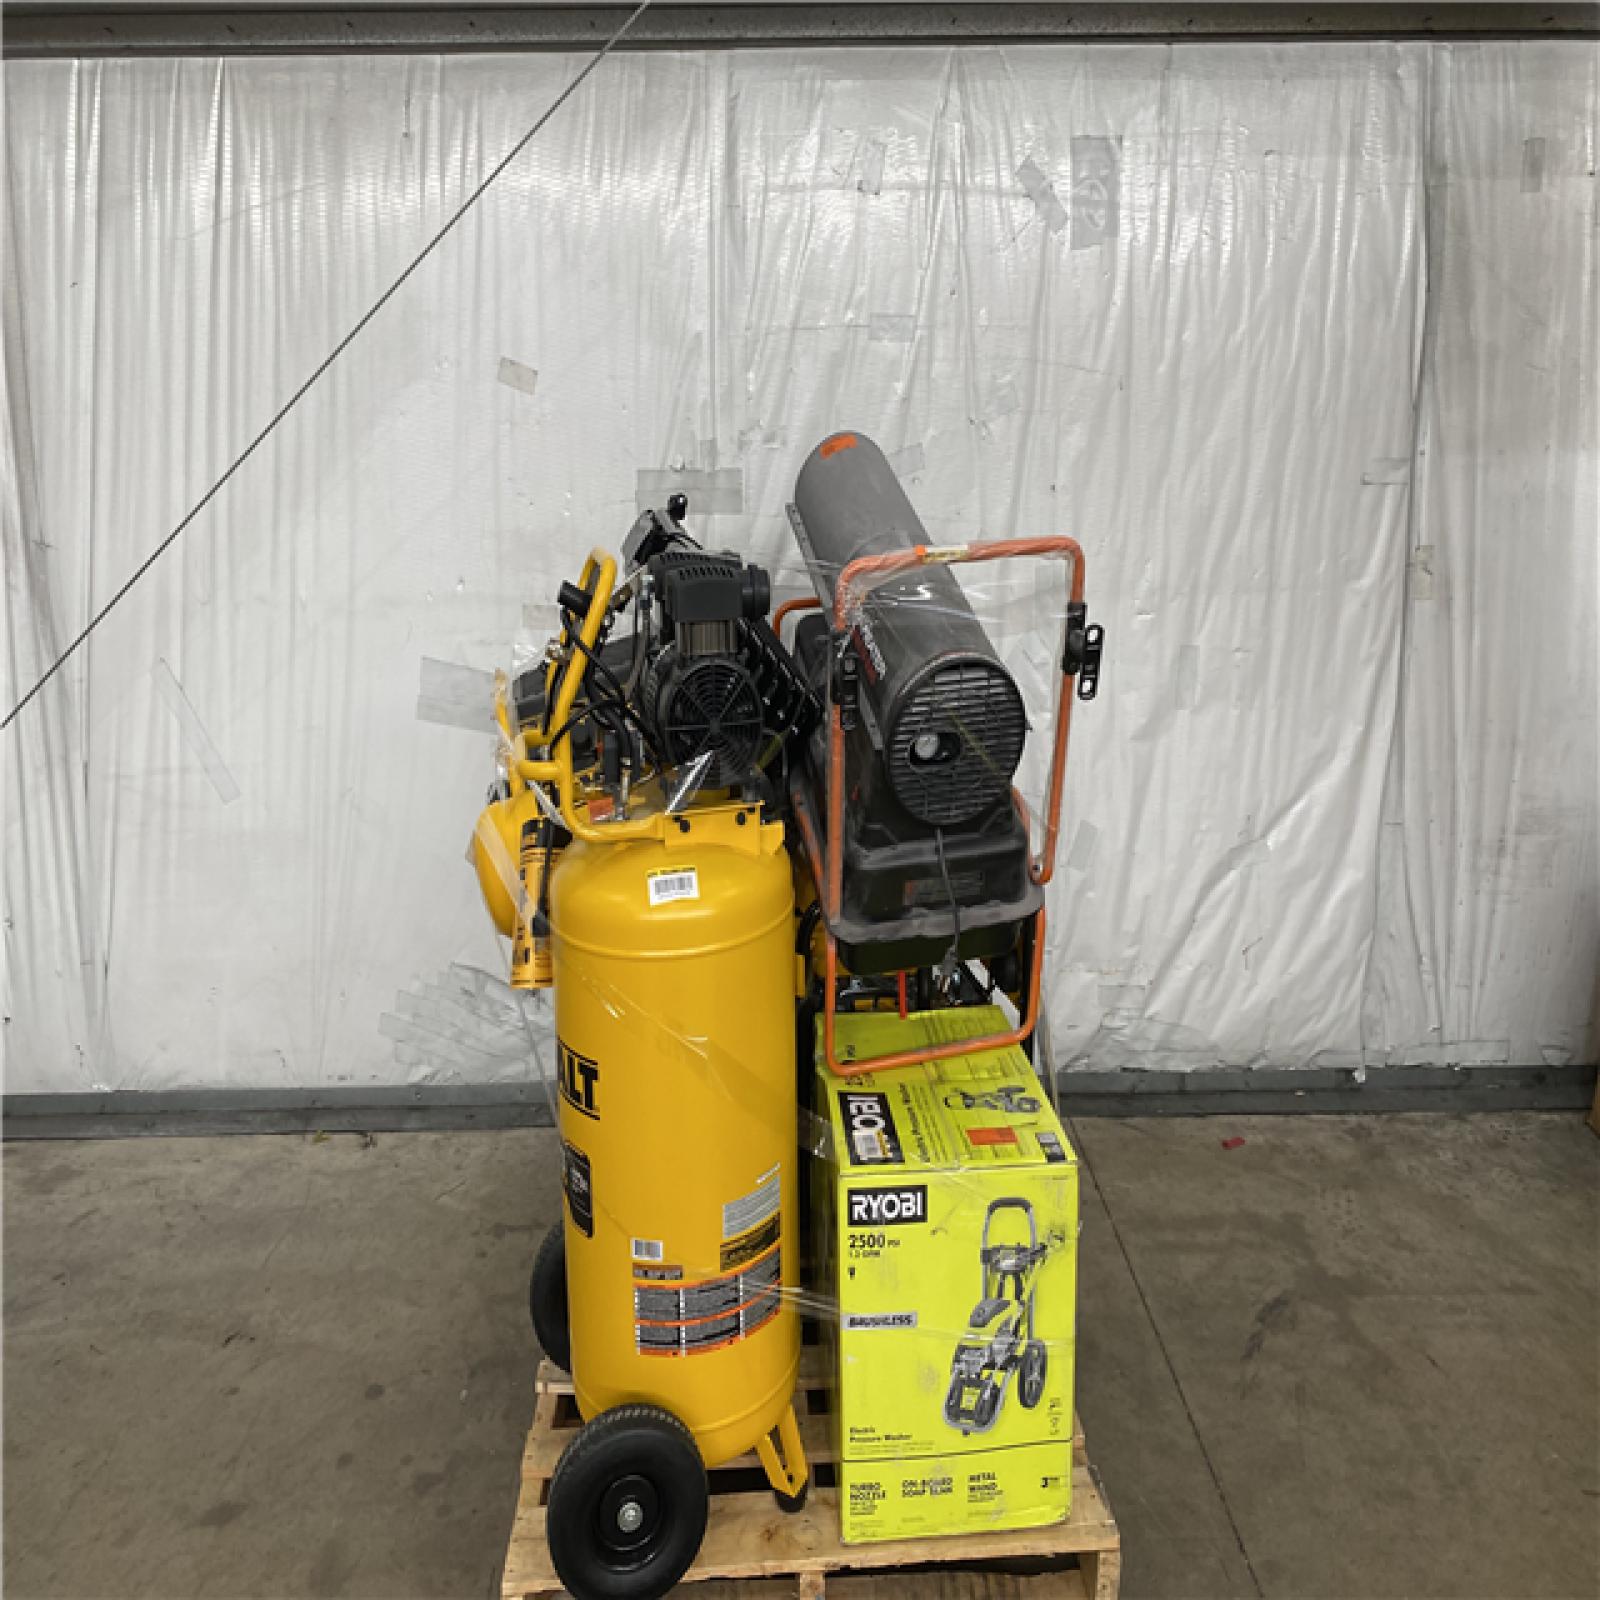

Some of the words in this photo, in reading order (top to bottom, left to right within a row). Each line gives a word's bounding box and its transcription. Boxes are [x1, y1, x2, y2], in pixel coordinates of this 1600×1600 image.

[852, 1192, 924, 1221] RYOBI
[849, 1233, 886, 1249] 2500
[849, 1314, 914, 1328] BRUSHLESS
[1040, 1476, 1049, 1488] 3
